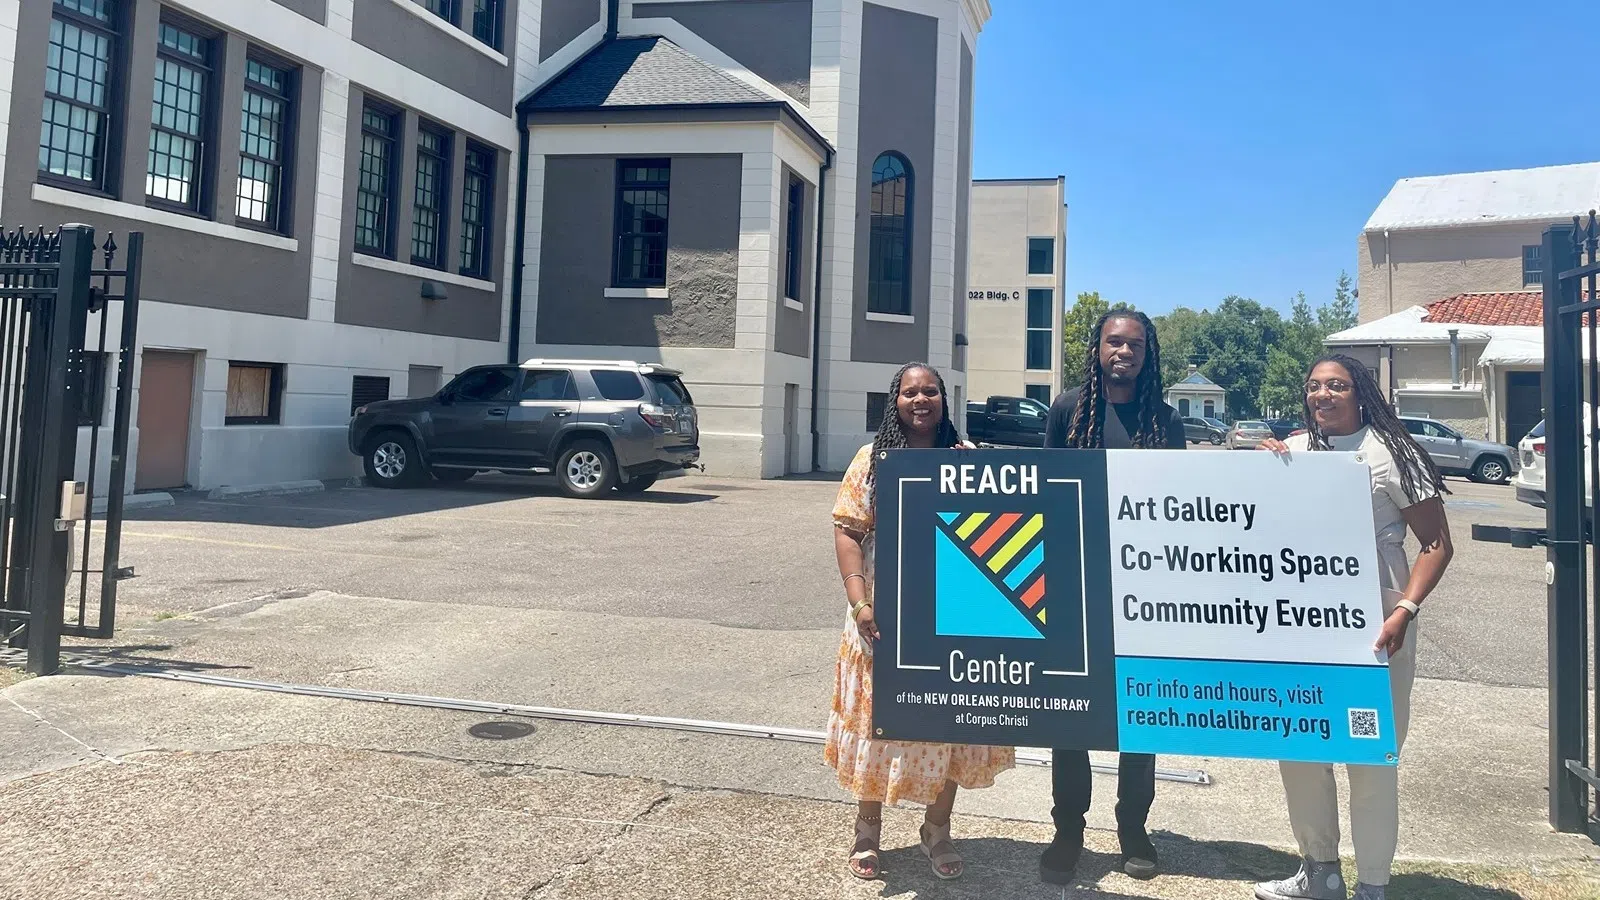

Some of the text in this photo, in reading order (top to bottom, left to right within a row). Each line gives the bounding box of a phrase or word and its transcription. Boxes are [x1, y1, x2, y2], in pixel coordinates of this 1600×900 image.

[986, 291, 1010, 302] Bldg.
[1012, 291, 1020, 300] C
[940, 464, 1038, 495] REACH
[1117, 495, 1256, 531] Art Gallery
[1120, 543, 1360, 584] Co-Working Space
[1122, 594, 1366, 634] Community Events
[949, 649, 1035, 685] Center
[896, 692, 1091, 712] of the NEW ORLEANS PUBLIC LIBRARY
[1126, 676, 1324, 708] For info and hours, visit
[955, 712, 1029, 728] at Corpus Christi
[1127, 706, 1331, 741] reach.nolalibrary.org
